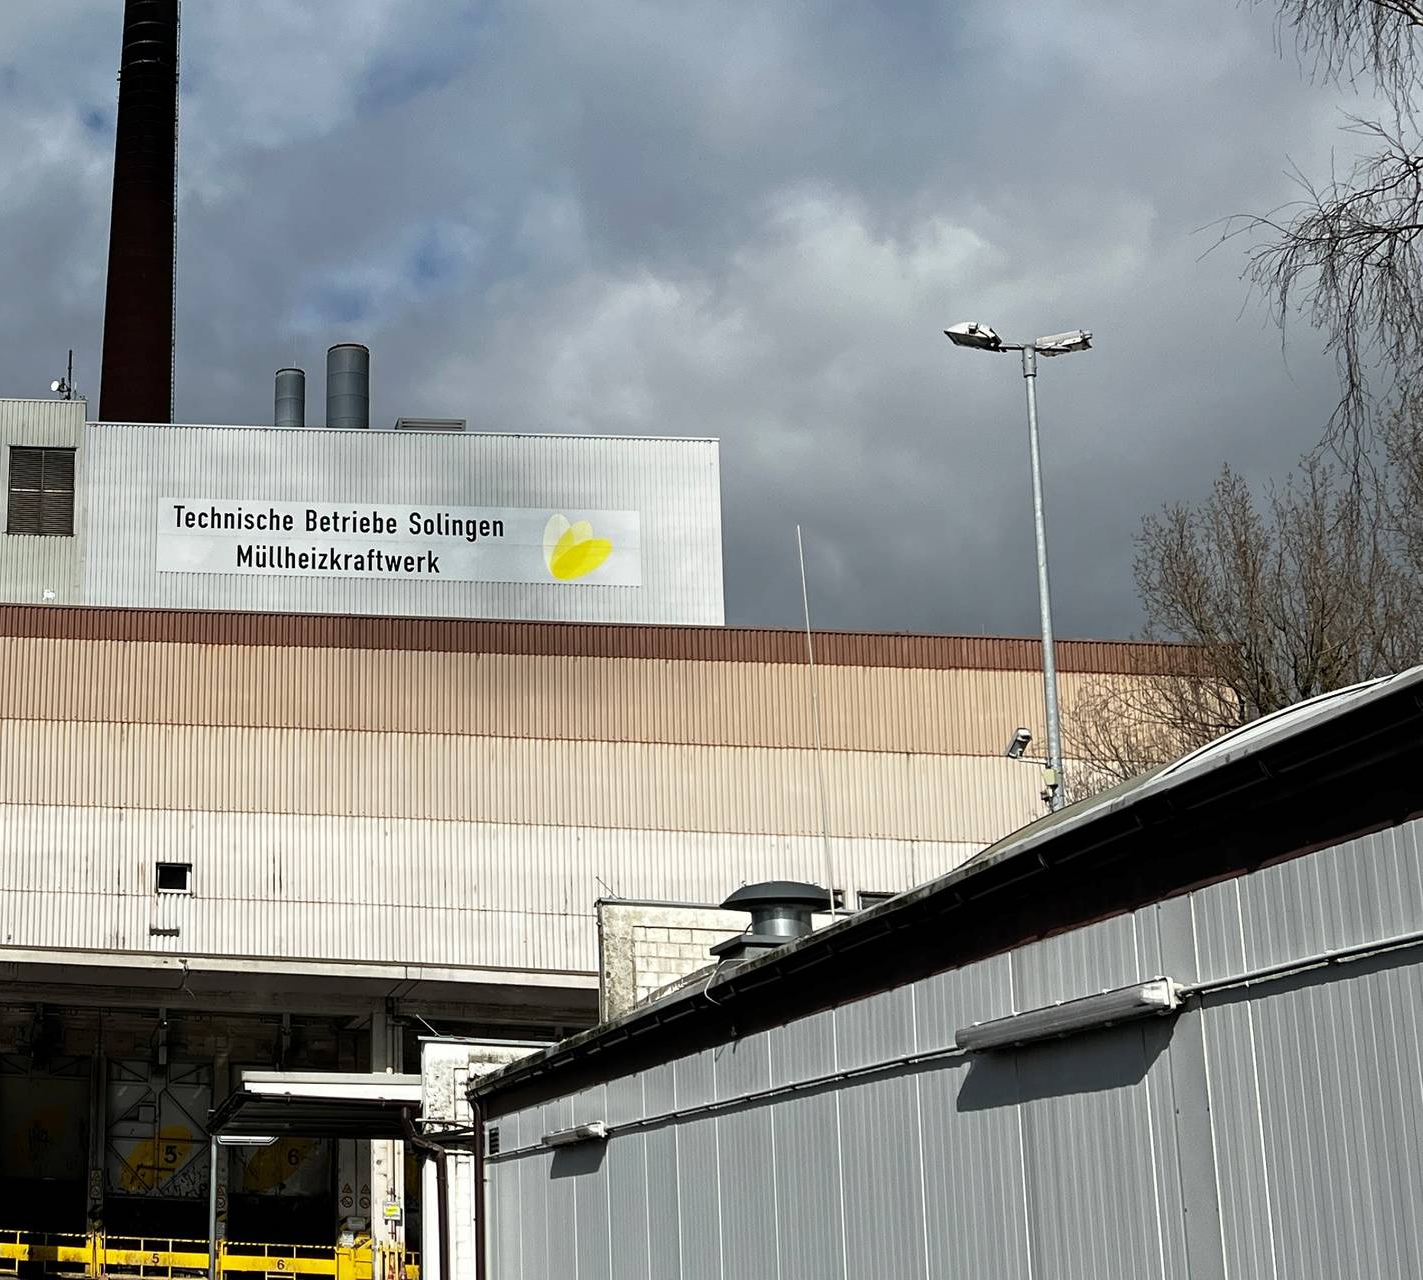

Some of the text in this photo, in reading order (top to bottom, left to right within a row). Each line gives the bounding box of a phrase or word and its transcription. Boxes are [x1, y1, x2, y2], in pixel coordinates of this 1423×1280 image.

[173, 505, 505, 543] Technische Betriebe Solingen
[237, 544, 441, 574] Müllheizkraftwerk
[163, 1145, 178, 1164] 5
[288, 1148, 300, 1166] 6
[152, 1253, 160, 1264] 5
[277, 1259, 285, 1270] 6
